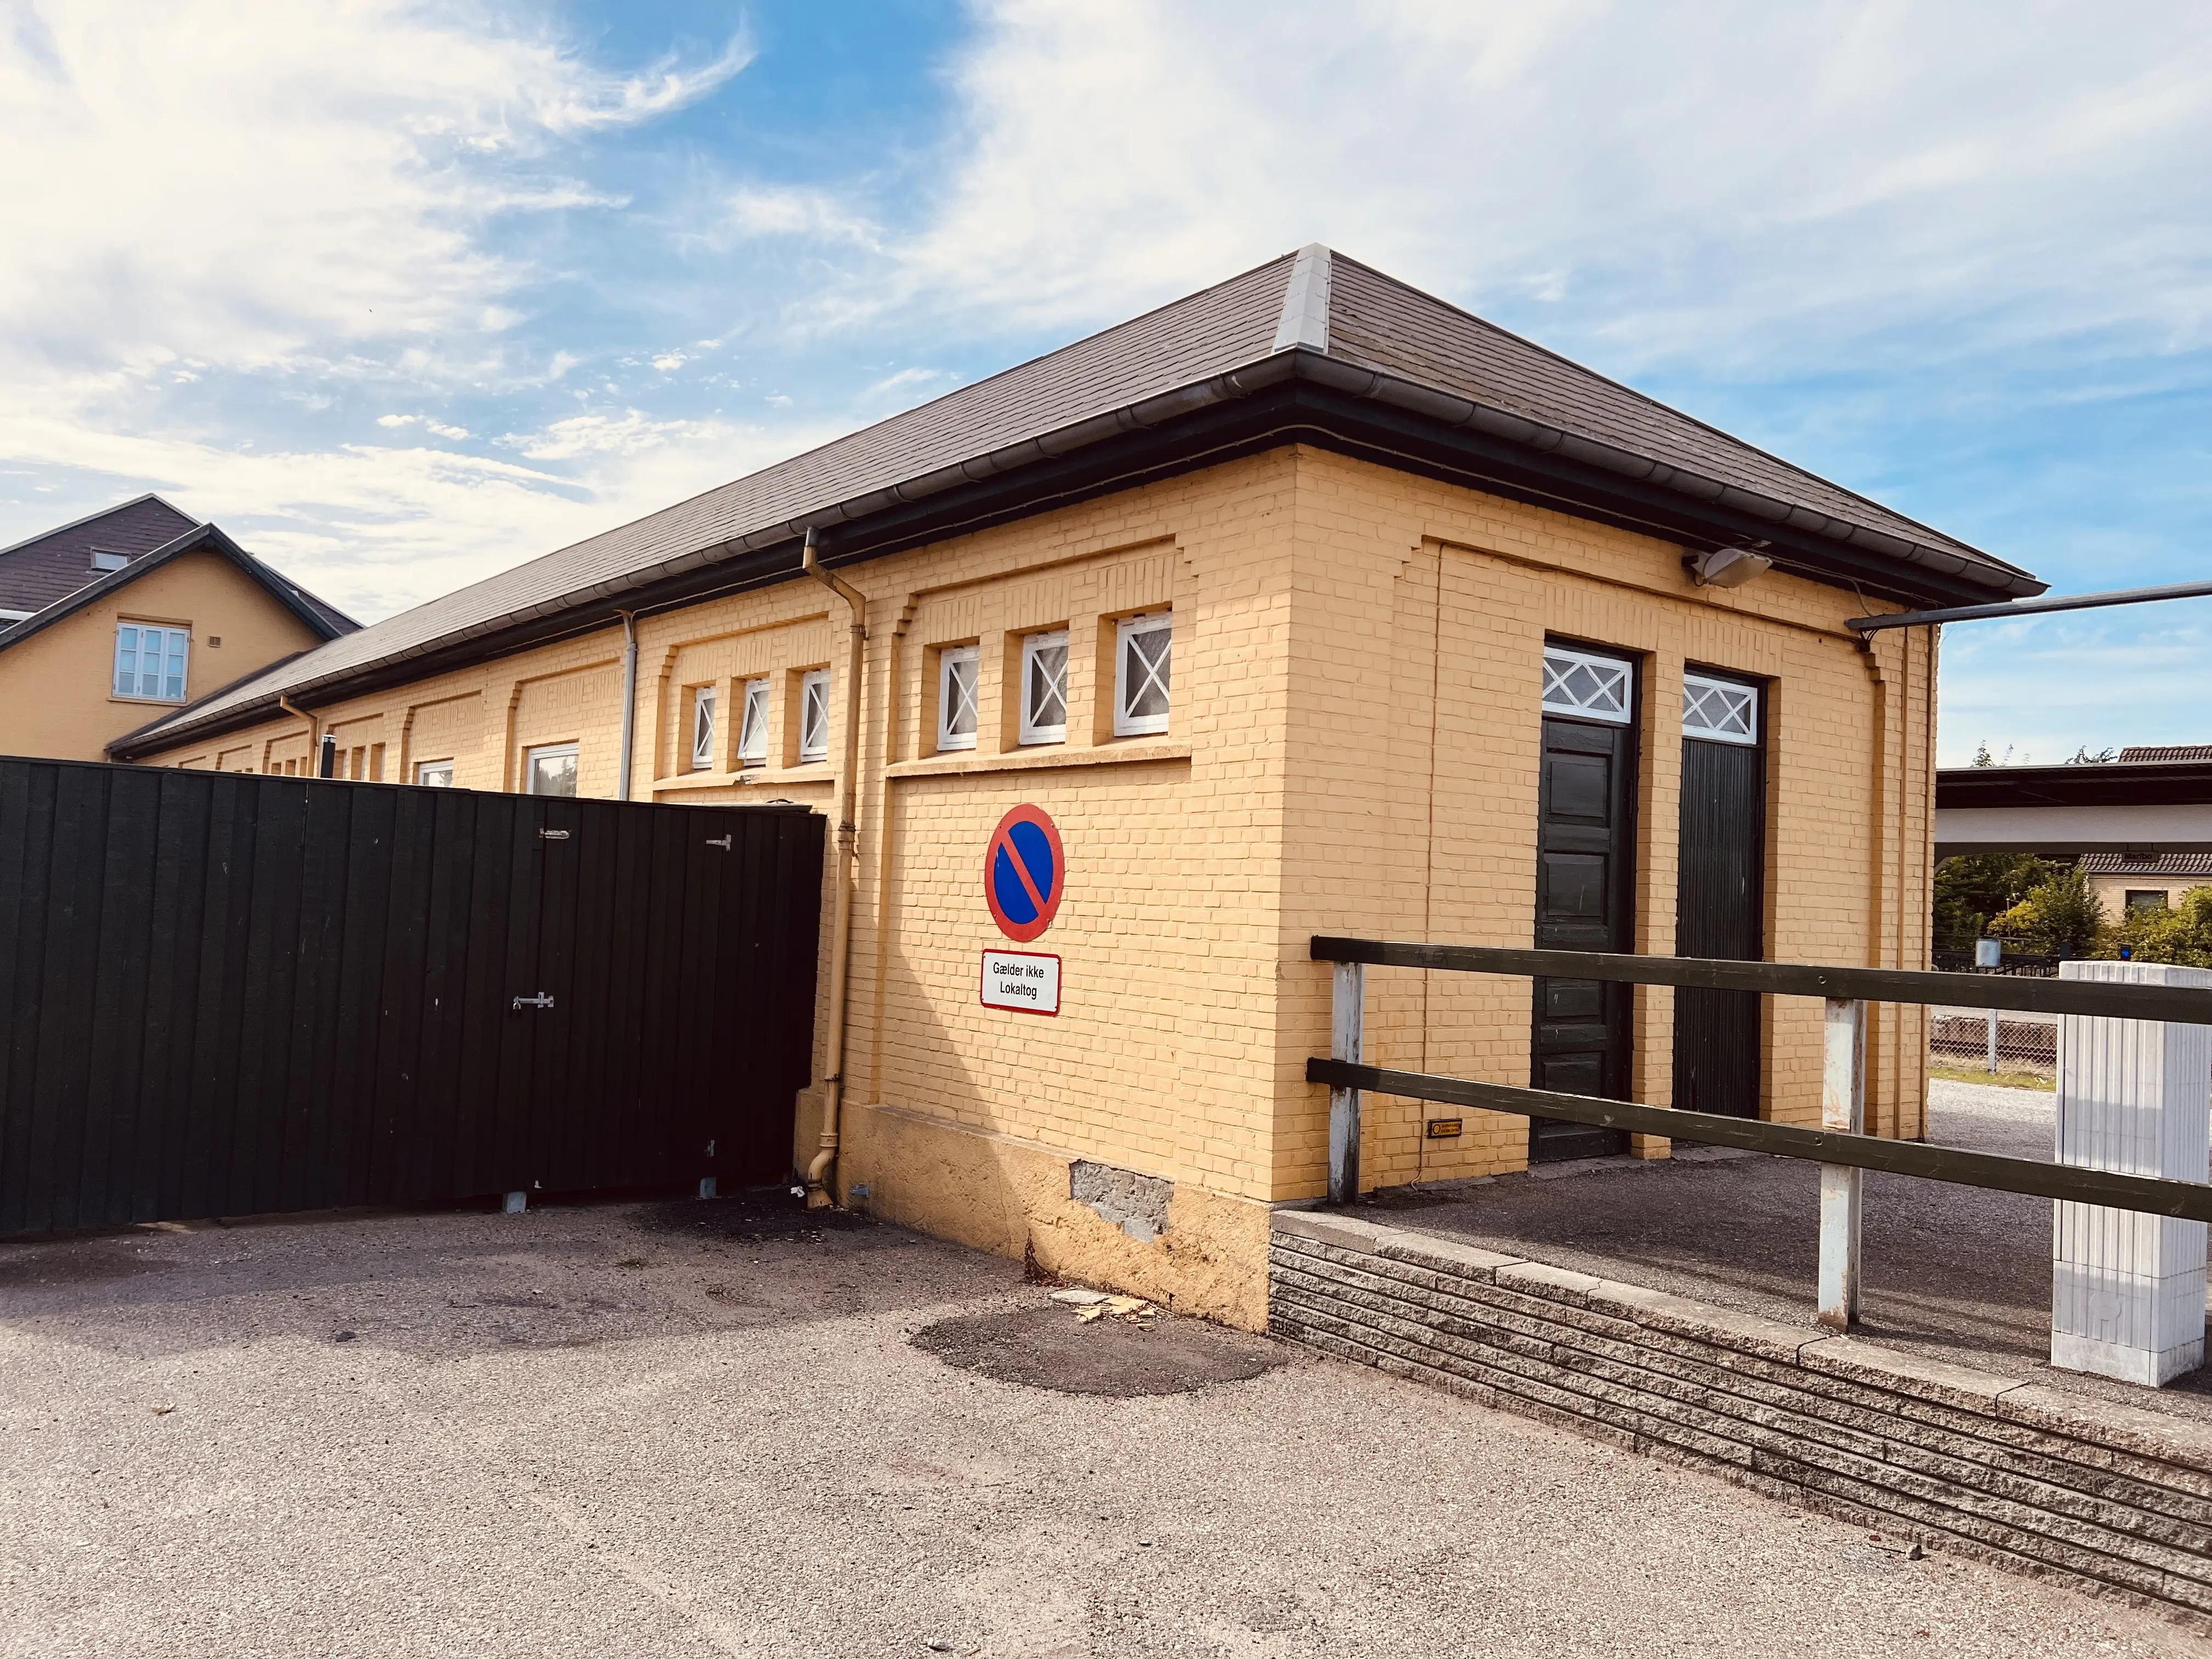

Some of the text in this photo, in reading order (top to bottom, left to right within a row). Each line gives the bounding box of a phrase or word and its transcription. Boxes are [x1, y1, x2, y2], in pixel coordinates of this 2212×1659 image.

[993, 962, 1044, 978] Gælder ikke
[1000, 981, 1037, 1000] Lokaltog
